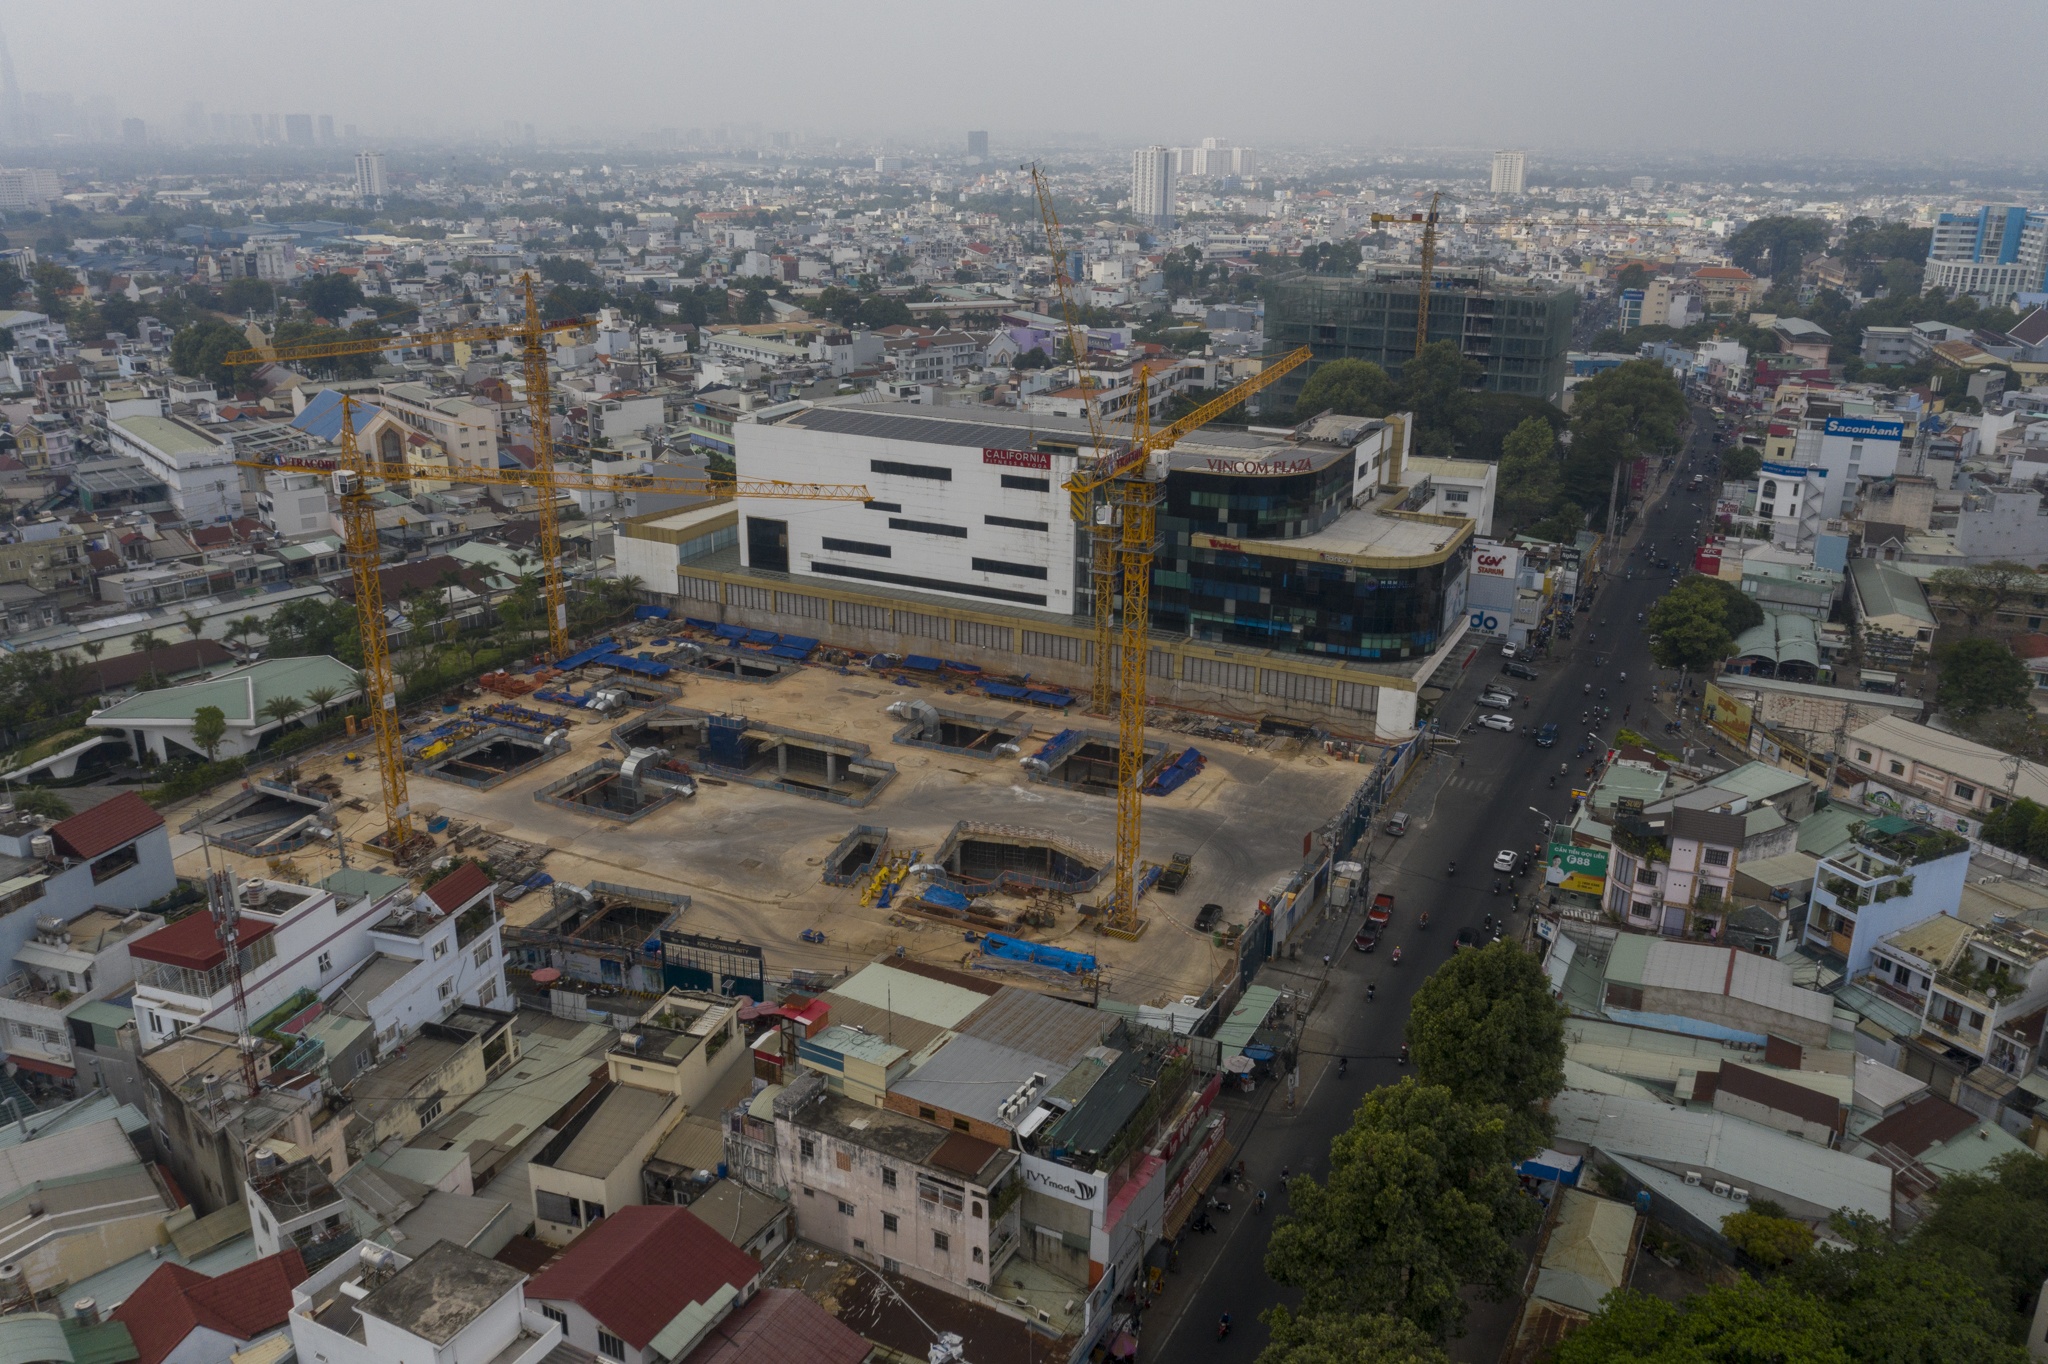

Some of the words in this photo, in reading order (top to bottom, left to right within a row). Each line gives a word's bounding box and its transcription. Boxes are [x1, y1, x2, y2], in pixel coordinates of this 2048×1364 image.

[1827, 420, 1901, 437] Sacombank
[985, 449, 1047, 463] CALIFORNIA
[1206, 459, 1270, 474] VINCOM
[1273, 457, 1312, 473] PLAZA
[1477, 554, 1503, 567] CGV
[1477, 566, 1505, 577] STARIUM
[1566, 854, 1591, 867] F88
[697, 941, 709, 949] KING
[710, 942, 727, 951] CROWN
[728, 945, 749, 954] INFINITY
[1026, 1168, 1076, 1195] IVYmoda
